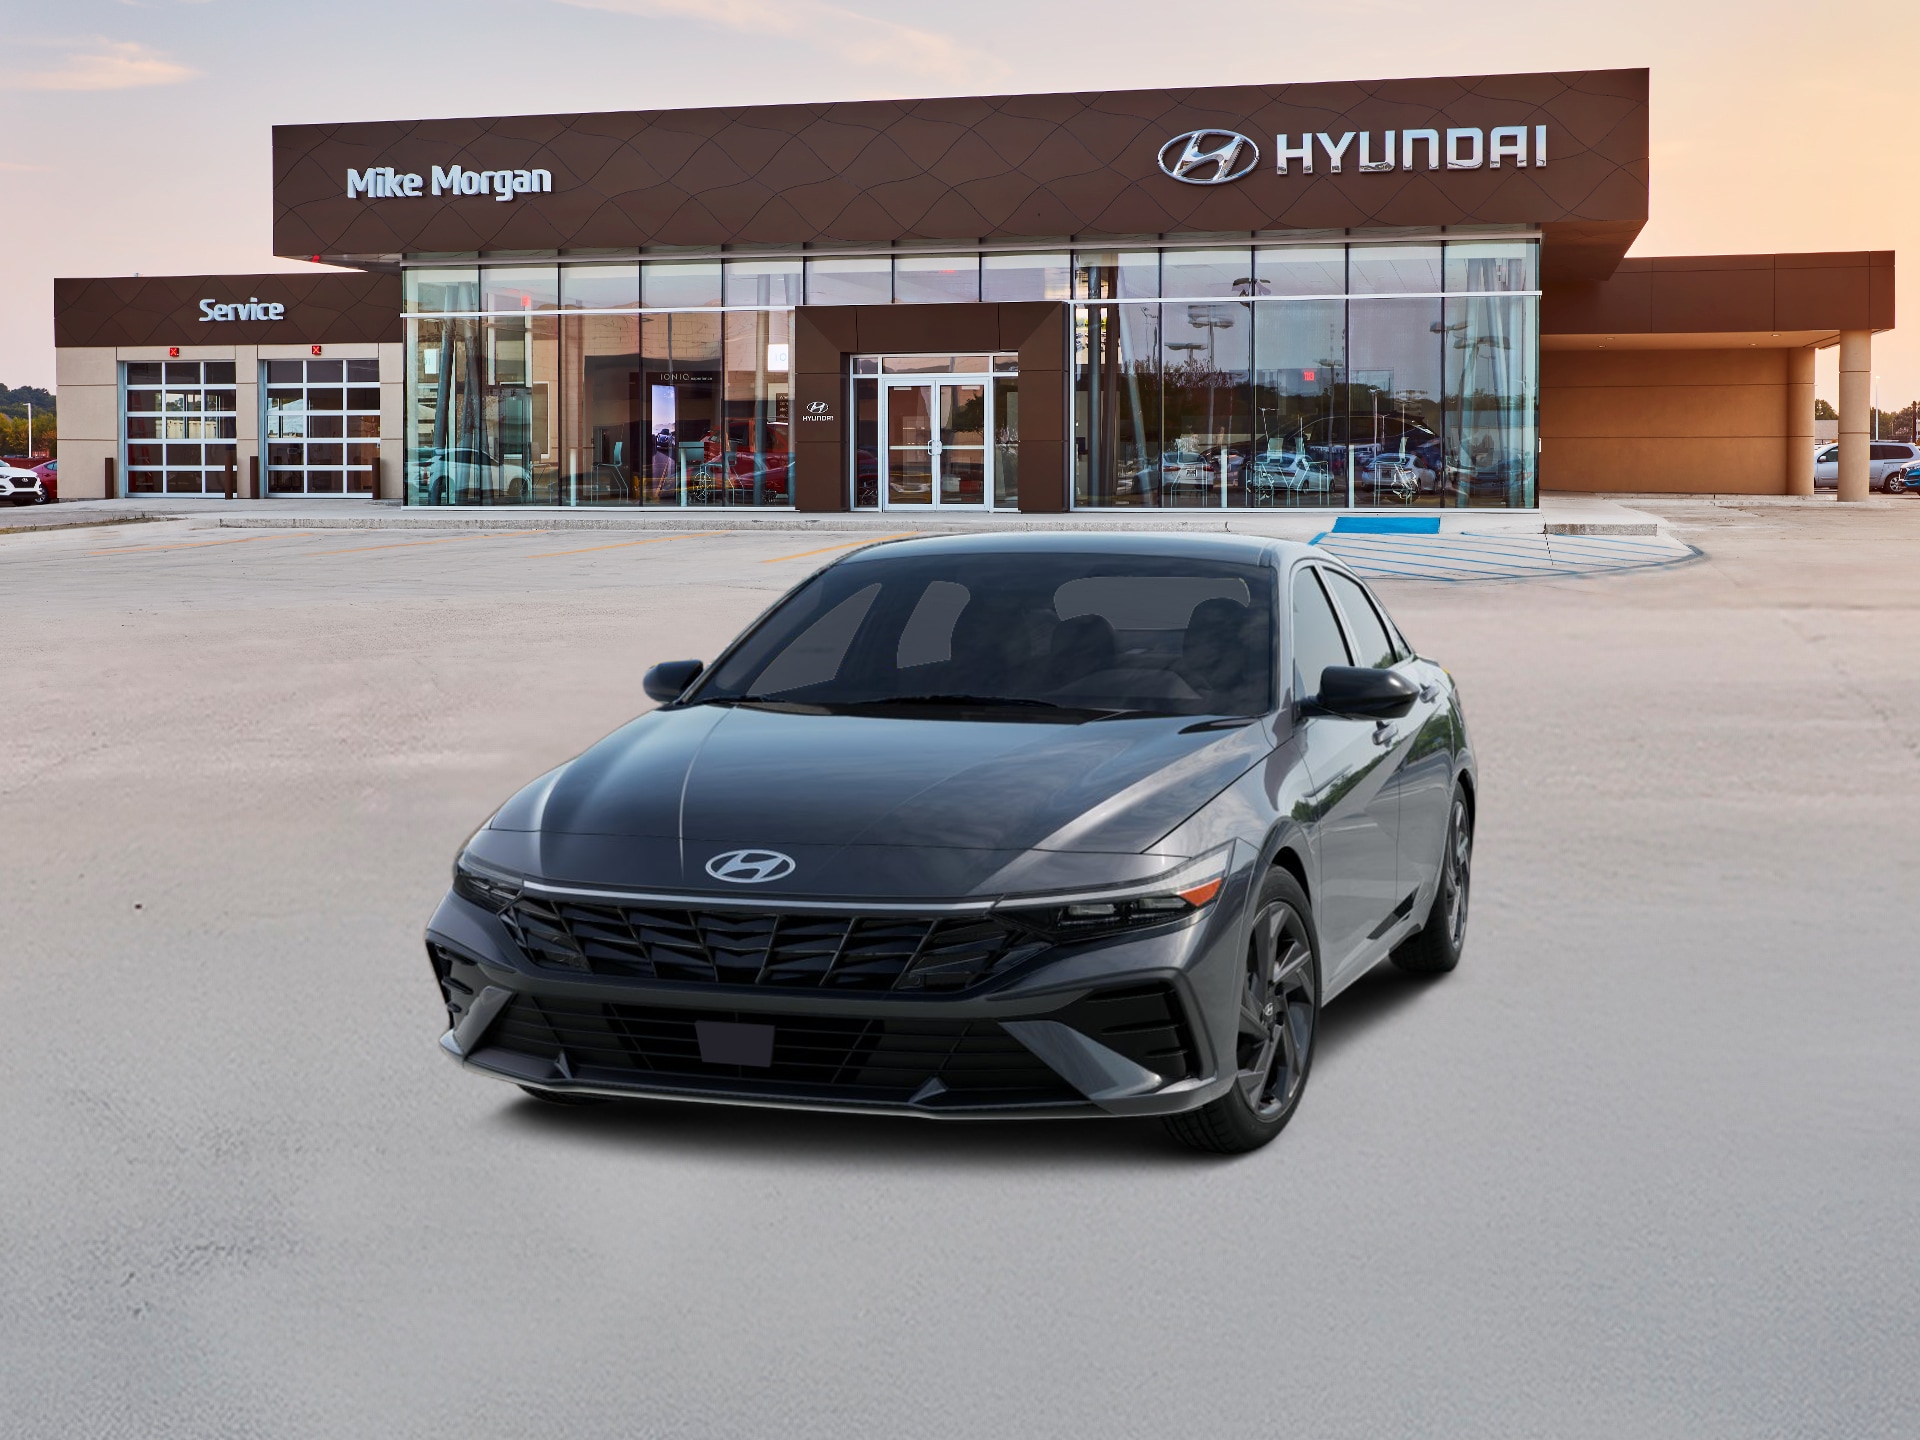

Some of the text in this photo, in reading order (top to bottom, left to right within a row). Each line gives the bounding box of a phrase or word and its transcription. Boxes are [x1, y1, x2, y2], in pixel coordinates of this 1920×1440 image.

[1276, 124, 1547, 175] HYUNDAI
[347, 165, 552, 201] Mike Morgan
[199, 297, 284, 321] Service
